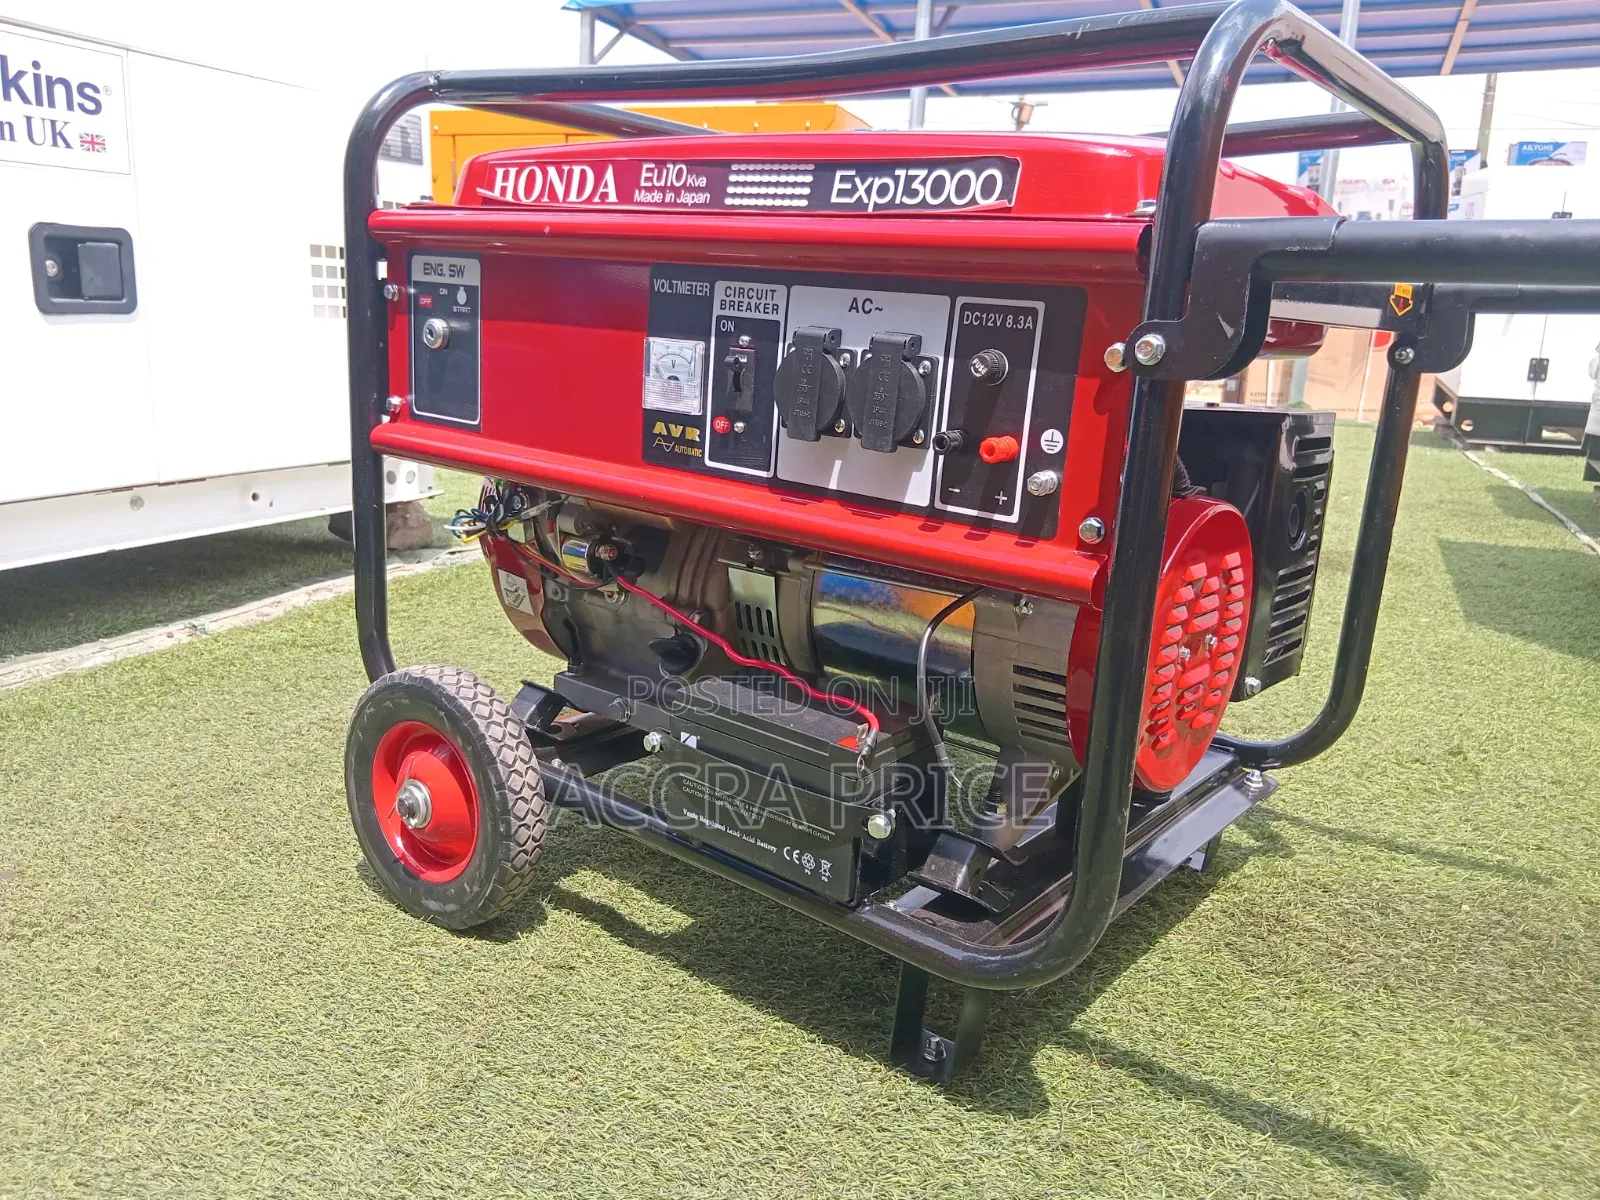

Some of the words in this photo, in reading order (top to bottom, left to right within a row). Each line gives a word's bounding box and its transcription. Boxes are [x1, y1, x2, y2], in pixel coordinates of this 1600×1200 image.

[23, 114, 75, 150] UK
[493, 164, 619, 203] HONDA
[639, 162, 688, 188] Eu10
[686, 174, 707, 188] Kva
[633, 188, 663, 203] Made
[664, 189, 676, 203] in
[676, 189, 711, 207] Japan
[830, 168, 1003, 212] Exp13000
[423, 262, 446, 277] ENG.
[448, 264, 466, 279] SW
[439, 287, 448, 295] ON
[653, 278, 711, 297] VOLTMETER
[724, 286, 777, 301] CIRCUIT
[719, 299, 780, 316] BREAKER
[720, 319, 735, 332] ON
[963, 311, 1004, 327] DC12V
[1005, 314, 1033, 330] 8.3A
[971, 358, 988, 376] FUSE
[652, 421, 700, 442] AVR
[715, 419, 729, 430] OFF
[674, 445, 703, 458] AUTOMATIC
[756, 838, 778, 854] Battery
